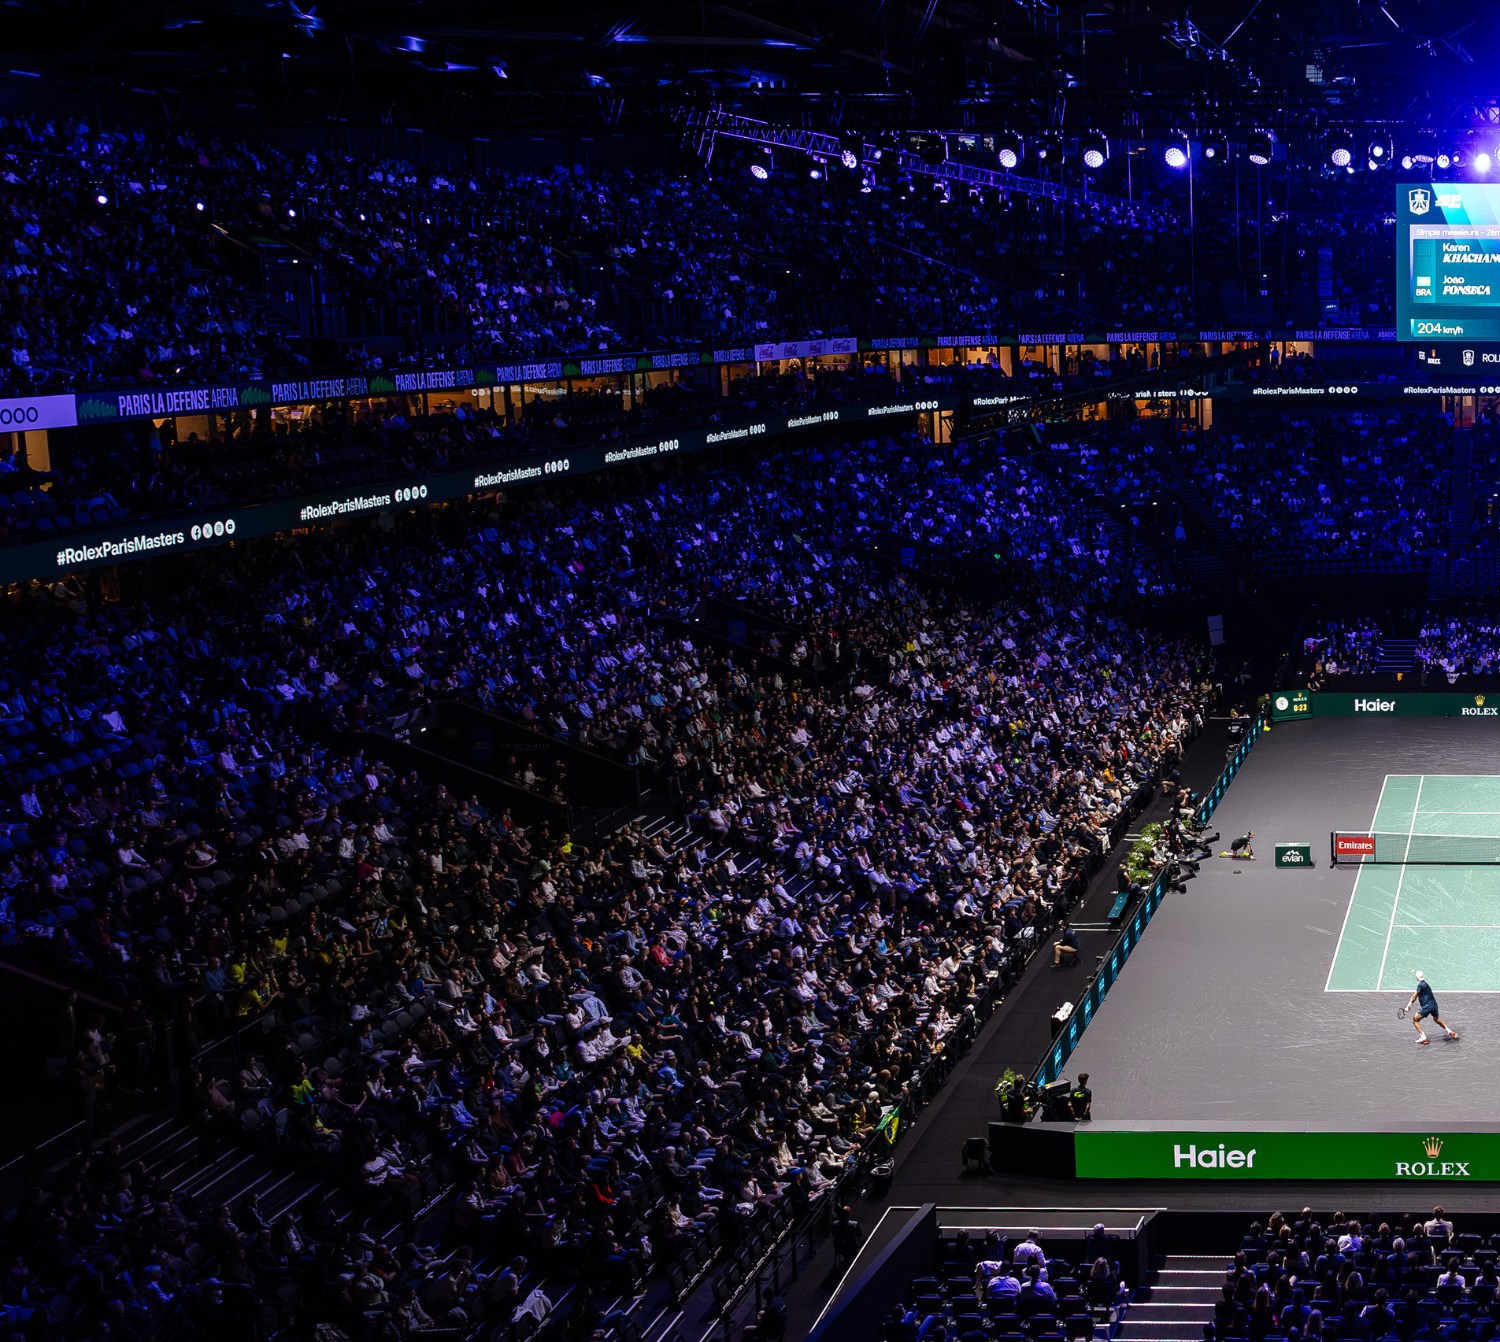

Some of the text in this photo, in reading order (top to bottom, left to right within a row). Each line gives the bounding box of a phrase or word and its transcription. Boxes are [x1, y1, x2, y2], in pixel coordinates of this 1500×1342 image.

[1416, 228, 1440, 237] Simple
[1442, 242, 1470, 252] Karen
[1442, 275, 1465, 284] Joao
[1442, 286, 1491, 295] FONSECA
[1296, 331, 1369, 339] PARIS LA DEFENSE ARENA
[1417, 323, 1464, 335] 204 km/h
[937, 336, 952, 346] PARIS
[952, 336, 958, 346] LA
[959, 336, 981, 345] DEFENSE
[1035, 334, 1041, 343] LA
[1068, 333, 1084, 342] ARENA
[1107, 332, 1176, 342] PARIS LA DEFENSE ARENA
[1200, 331, 1217, 340] PARIS
[1218, 331, 1226, 340] LA
[497, 362, 562, 382] PARIS LA DEFENSE ARENA
[580, 360, 595, 375] PARIS
[595, 360, 601, 374] LA
[602, 358, 623, 374] DEFENSE
[395, 370, 474, 391] PARIS LA DEFENSE ARENA
[272, 378, 368, 403] PARIS LA DEFENSE ARENA
[1252, 386, 1324, 395] #RolexParisMasters
[1403, 386, 1476, 394] #RolexParisMasters
[119, 387, 238, 416] PARIS LA DEFENSE ARENA
[868, 404, 914, 416] #RolexParisMasters
[706, 429, 748, 444] #RolexParisMasters
[604, 443, 658, 463] #RolexParisMasters
[474, 466, 542, 488] #RolexParisMasters
[300, 492, 391, 522] #RolexParisMasters
[56, 530, 185, 566] #RolexParisMasters
[1354, 699, 1395, 712] Haier
[1338, 841, 1373, 850] Emirates
[1173, 1143, 1257, 1169] Haier
[1395, 1162, 1470, 1176] ROLEX
